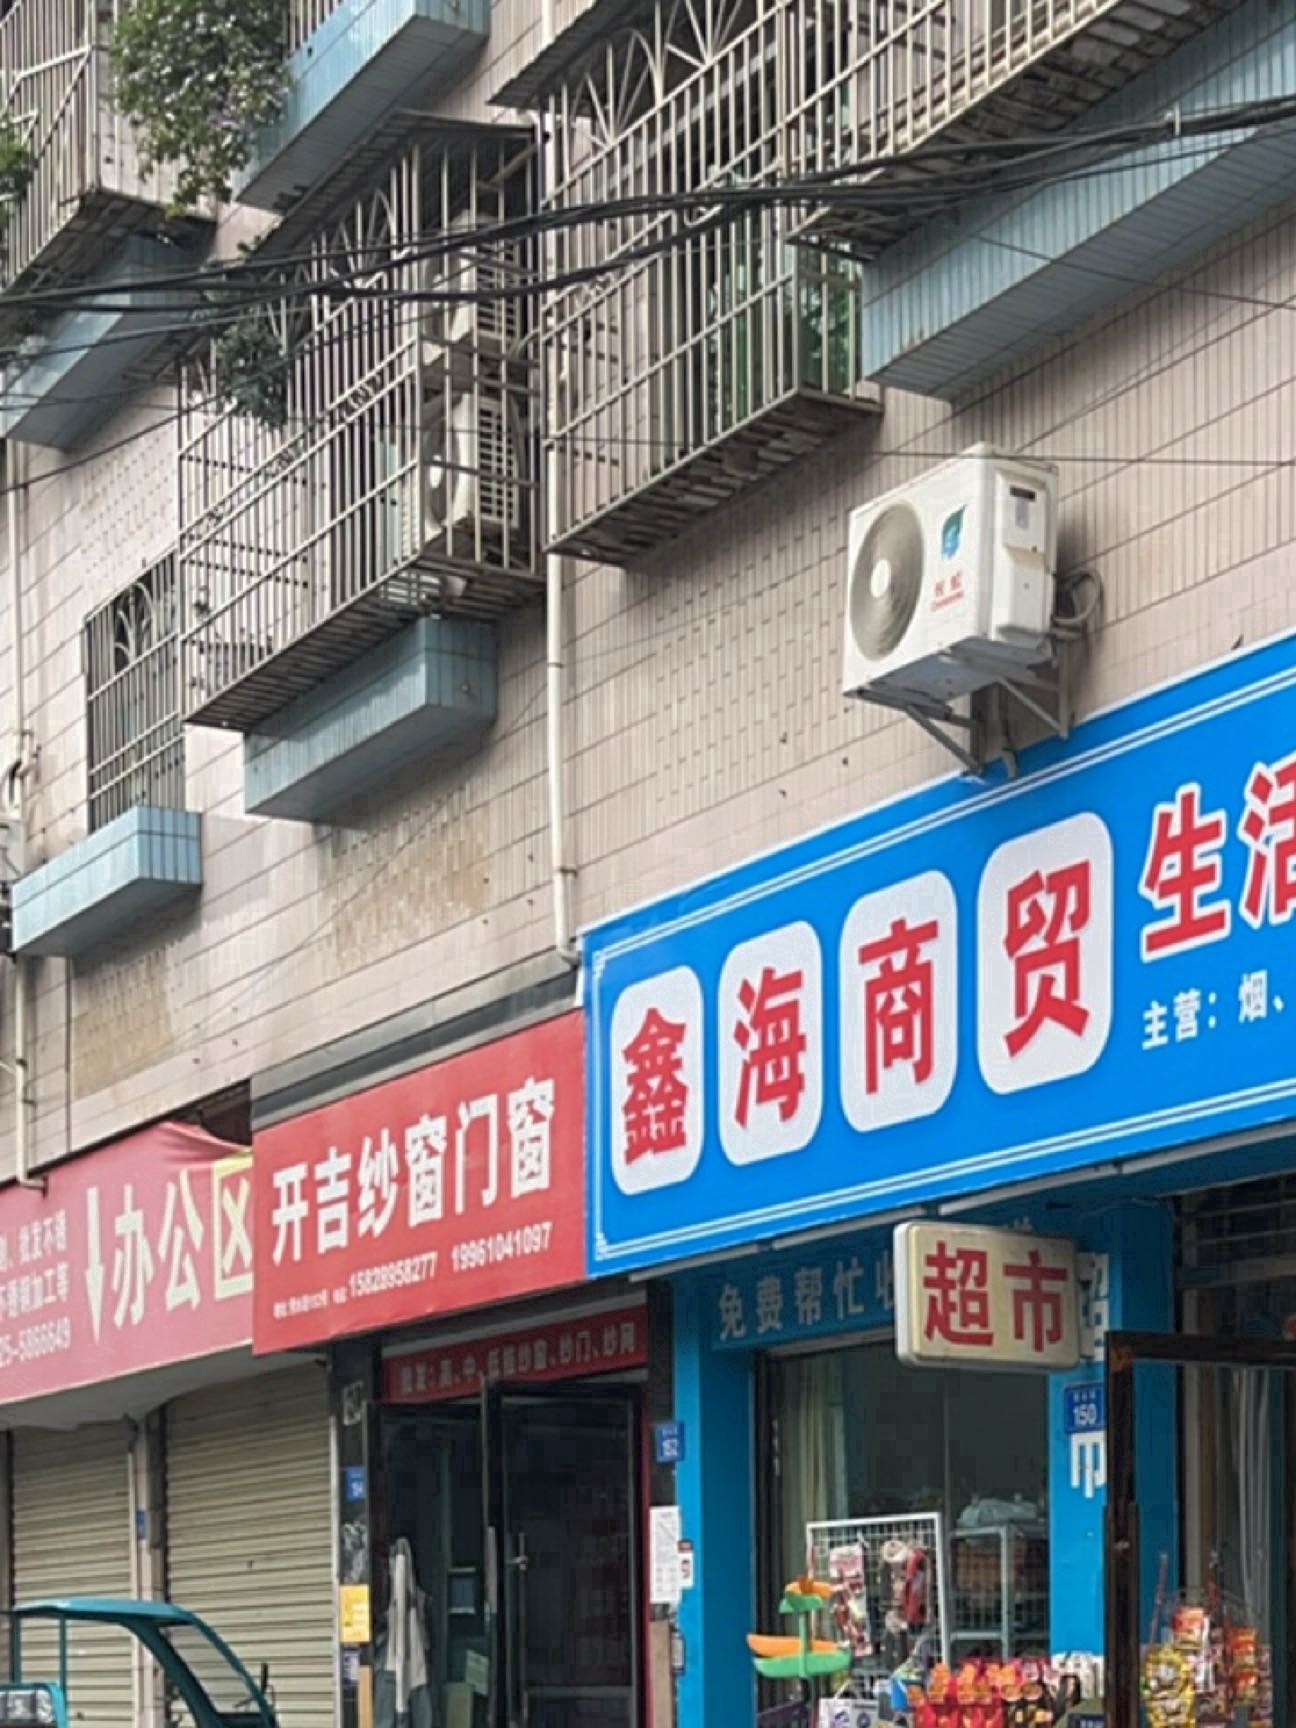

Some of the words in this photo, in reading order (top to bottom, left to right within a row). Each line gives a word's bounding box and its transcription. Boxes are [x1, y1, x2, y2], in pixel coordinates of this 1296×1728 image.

[622, 859, 1091, 1166] 鑫海商贸
[110, 1155, 254, 1330] 办公区
[271, 1076, 556, 1267] 开吉纱窗门窗
[922, 1239, 1069, 1353] 超市
